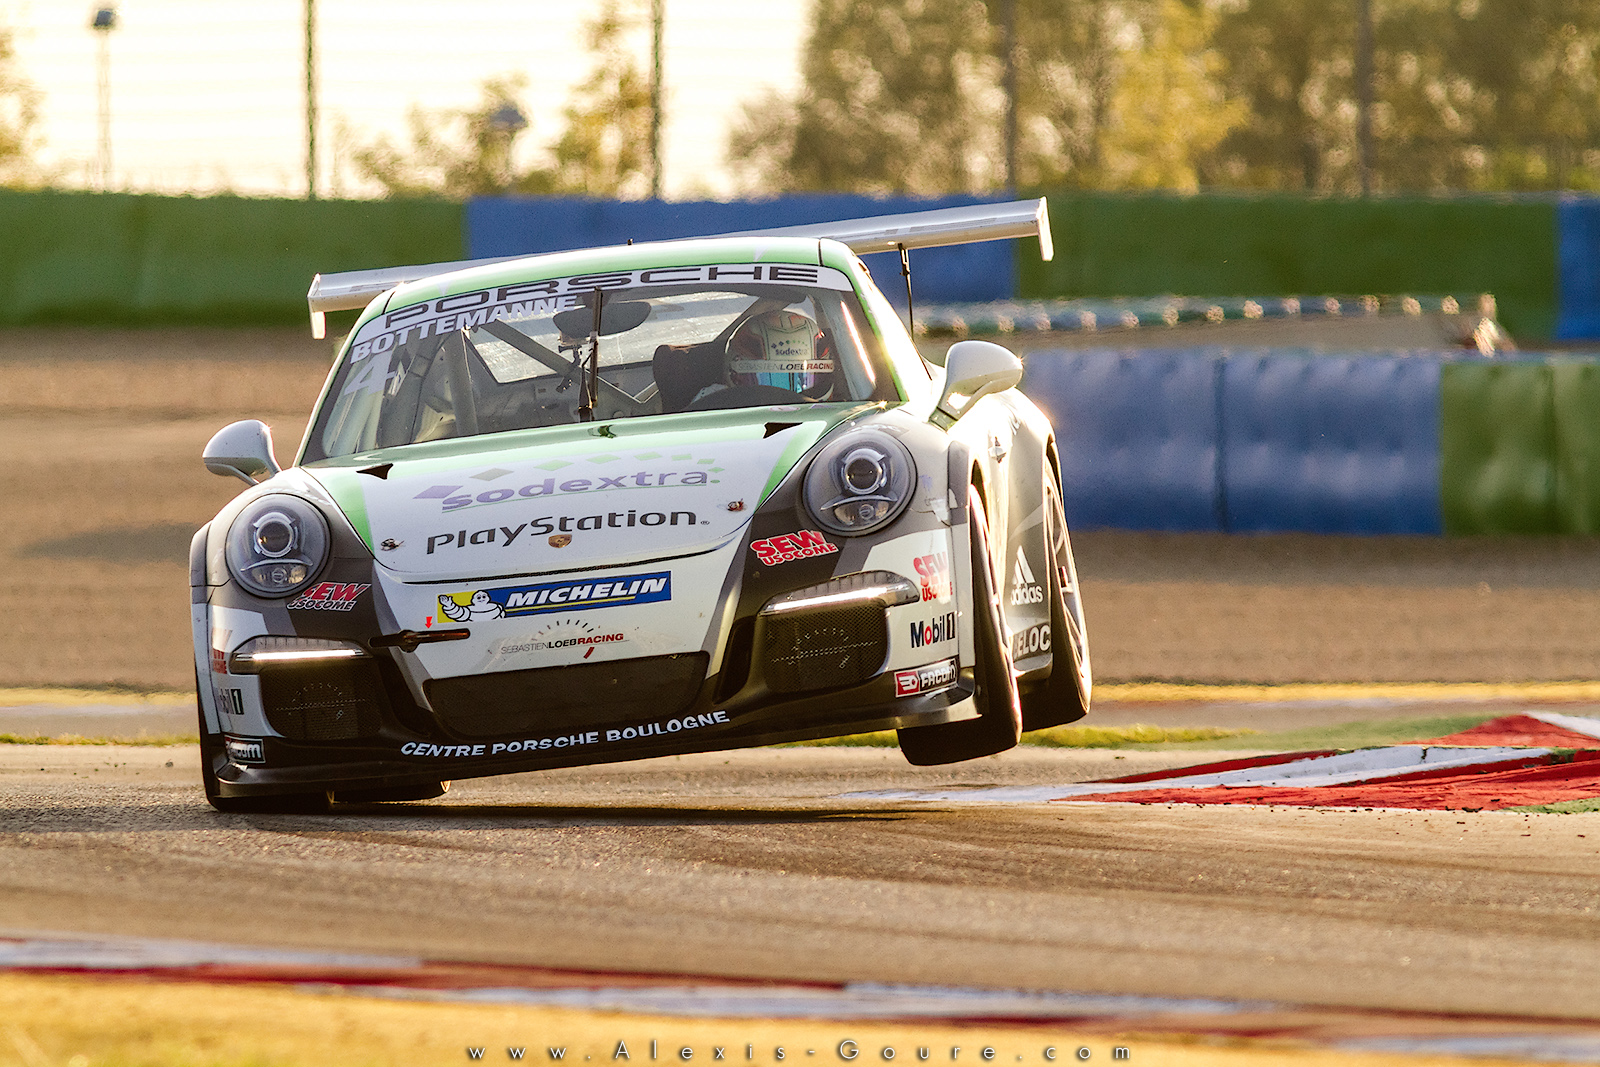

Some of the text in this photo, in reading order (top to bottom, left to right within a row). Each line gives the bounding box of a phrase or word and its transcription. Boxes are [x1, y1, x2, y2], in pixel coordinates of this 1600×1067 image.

[385, 265, 818, 329] PORSCHE
[350, 295, 577, 364] BOTTEMANNE
[343, 350, 396, 396] 4
[441, 471, 708, 511] sodextra
[426, 509, 697, 555] PlayStation
[752, 529, 826, 560] SEW
[762, 543, 839, 566] USOCOME
[913, 551, 949, 588] SEW
[505, 577, 667, 608] MICHELIN
[1010, 584, 1044, 606] adidas
[910, 614, 946, 648] Mobil
[400, 711, 730, 757] CENTRE PORSCHE BOULOGNE
